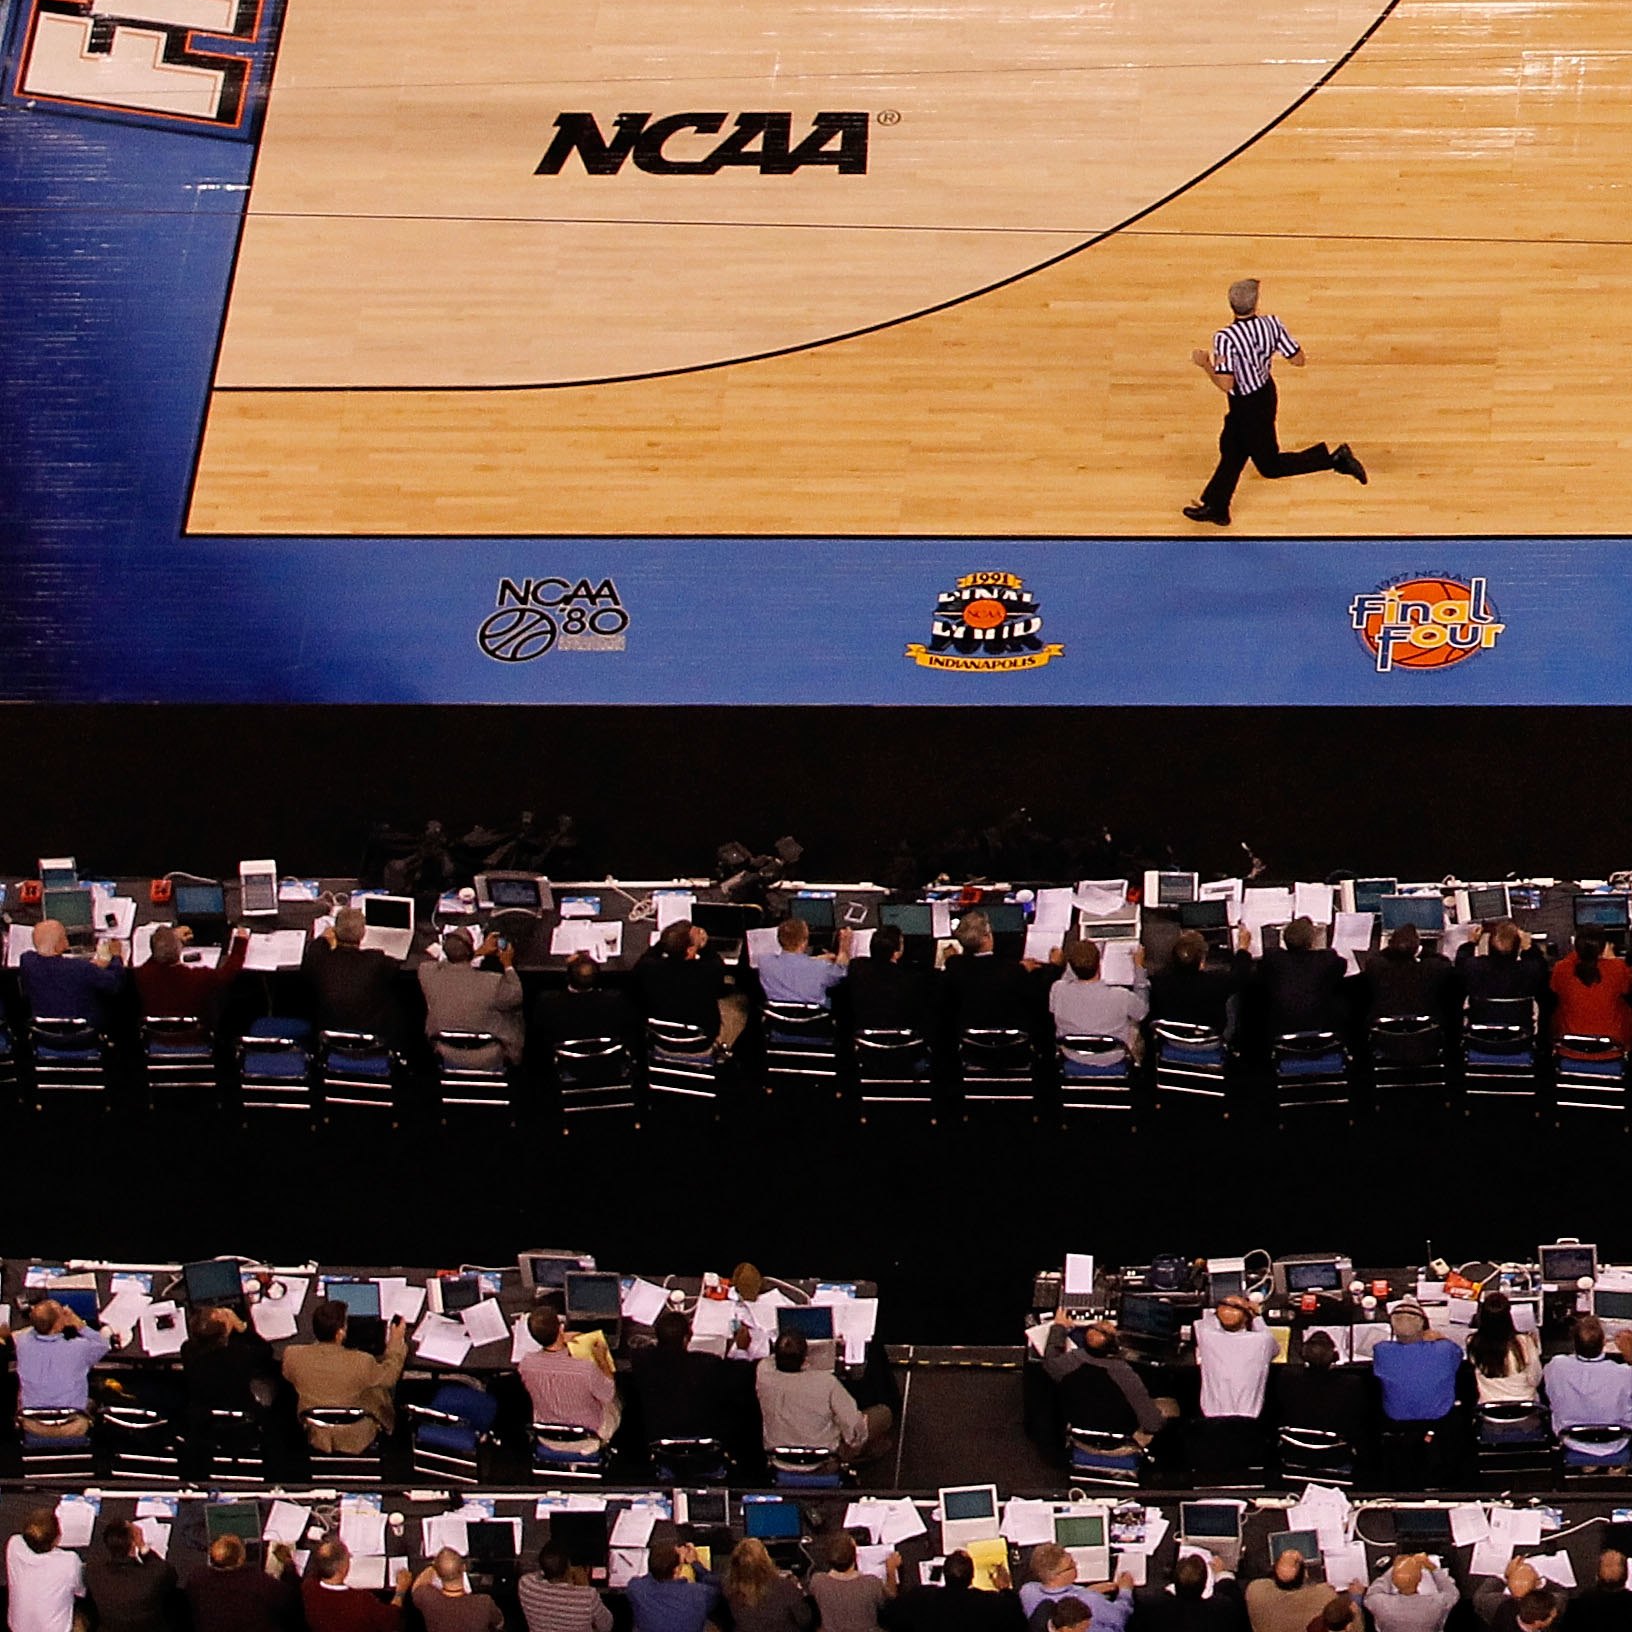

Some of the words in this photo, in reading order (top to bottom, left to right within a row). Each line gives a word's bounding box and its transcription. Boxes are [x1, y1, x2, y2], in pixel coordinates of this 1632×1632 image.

[532, 111, 871, 176] NCAA
[971, 572, 1010, 585] 1991
[497, 577, 622, 608] NCAA
[928, 655, 1037, 670] INDIANAPOLIS
